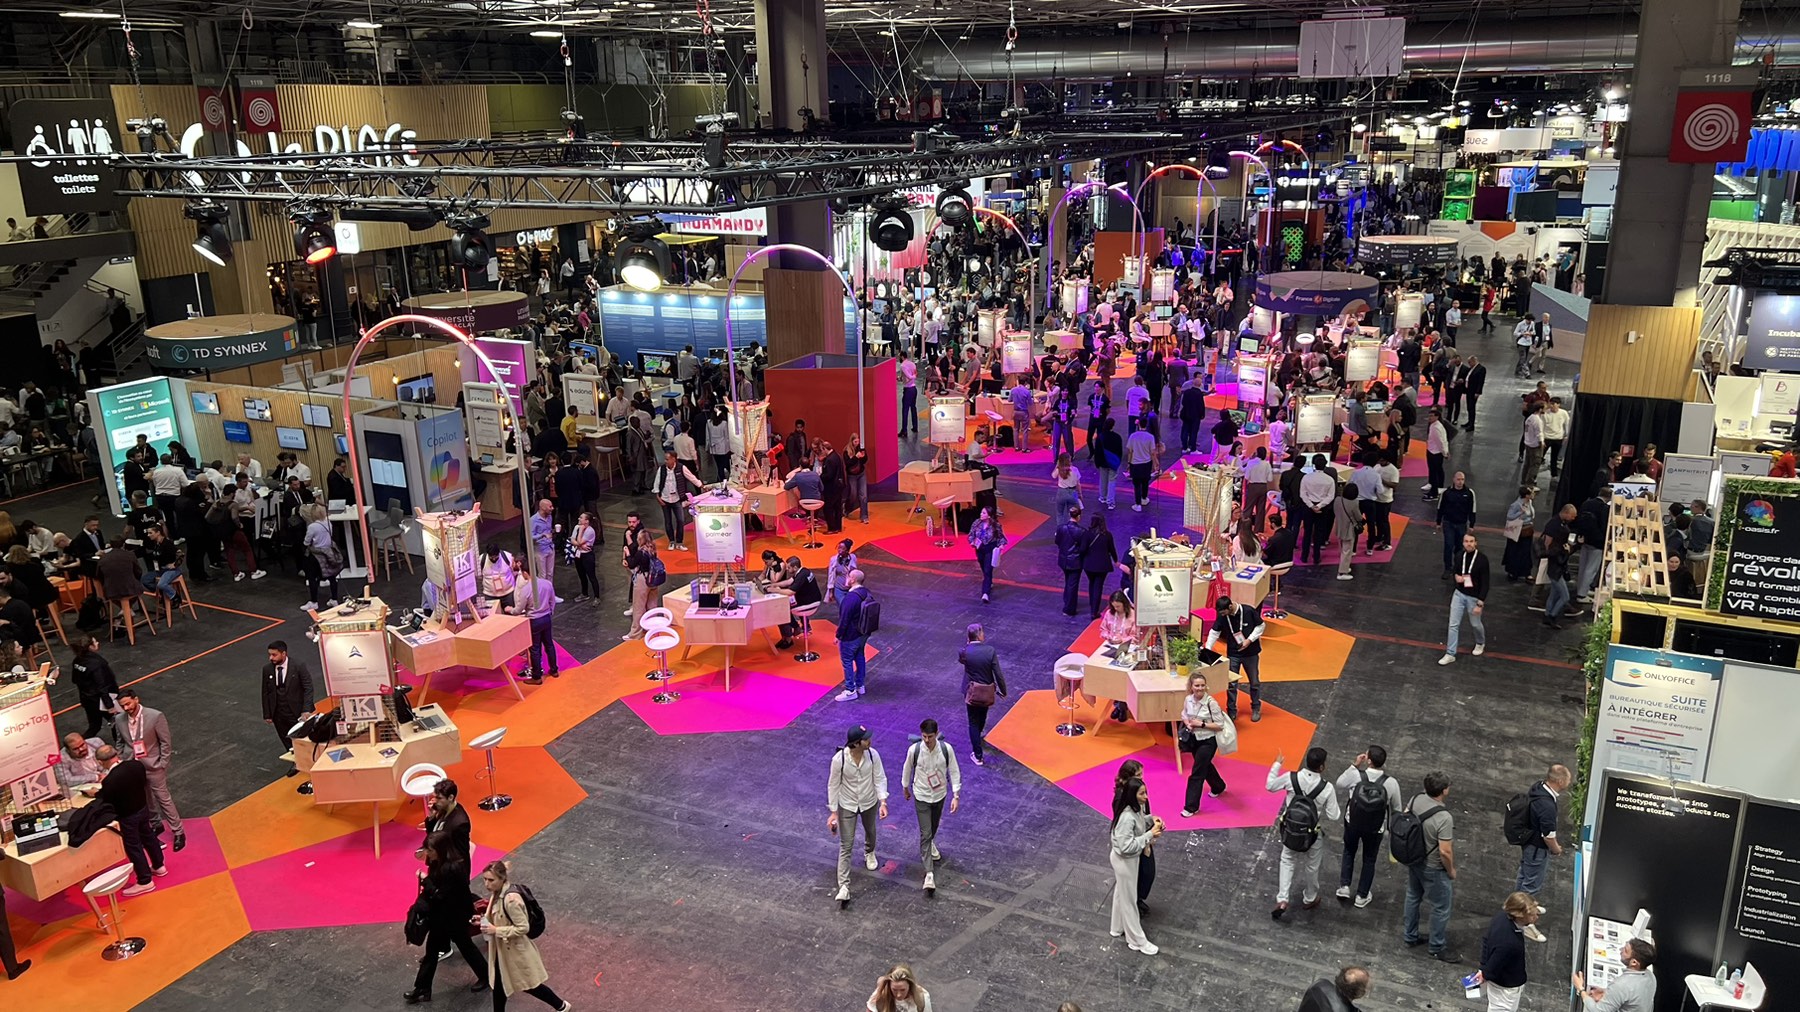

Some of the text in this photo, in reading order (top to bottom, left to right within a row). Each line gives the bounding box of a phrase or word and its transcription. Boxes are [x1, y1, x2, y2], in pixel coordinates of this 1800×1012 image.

[1705, 74, 1731, 83] 1118
[53, 174, 100, 183] toilettes
[62, 184, 96, 194] toilets
[192, 341, 268, 358] TD SYNNEX
[427, 432, 457, 448] Copilot
[706, 531, 732, 540] palmear
[1734, 551, 1800, 565] Plongez da
[1732, 560, 1800, 580] révol
[1729, 578, 1744, 587] de
[1728, 590, 1759, 600] notre
[1726, 598, 1755, 611] VR
[1644, 672, 1696, 685] ONLYOFFICE
[1671, 695, 1707, 708] SUITE
[1608, 703, 1678, 722] À INTÉGRER
[4, 714, 50, 736] Ship+Tag
[1616, 796, 1660, 808] prototypes,
[1714, 808, 1730, 819] into
[1616, 802, 1676, 817] success stories.
[1692, 800, 1708, 808] into
[1754, 845, 1783, 856] Strategy
[1751, 865, 1775, 875] Design
[1747, 885, 1787, 899] Prototyping
[1744, 906, 1797, 921] Industrialization
[1740, 926, 1765, 936] Launch
